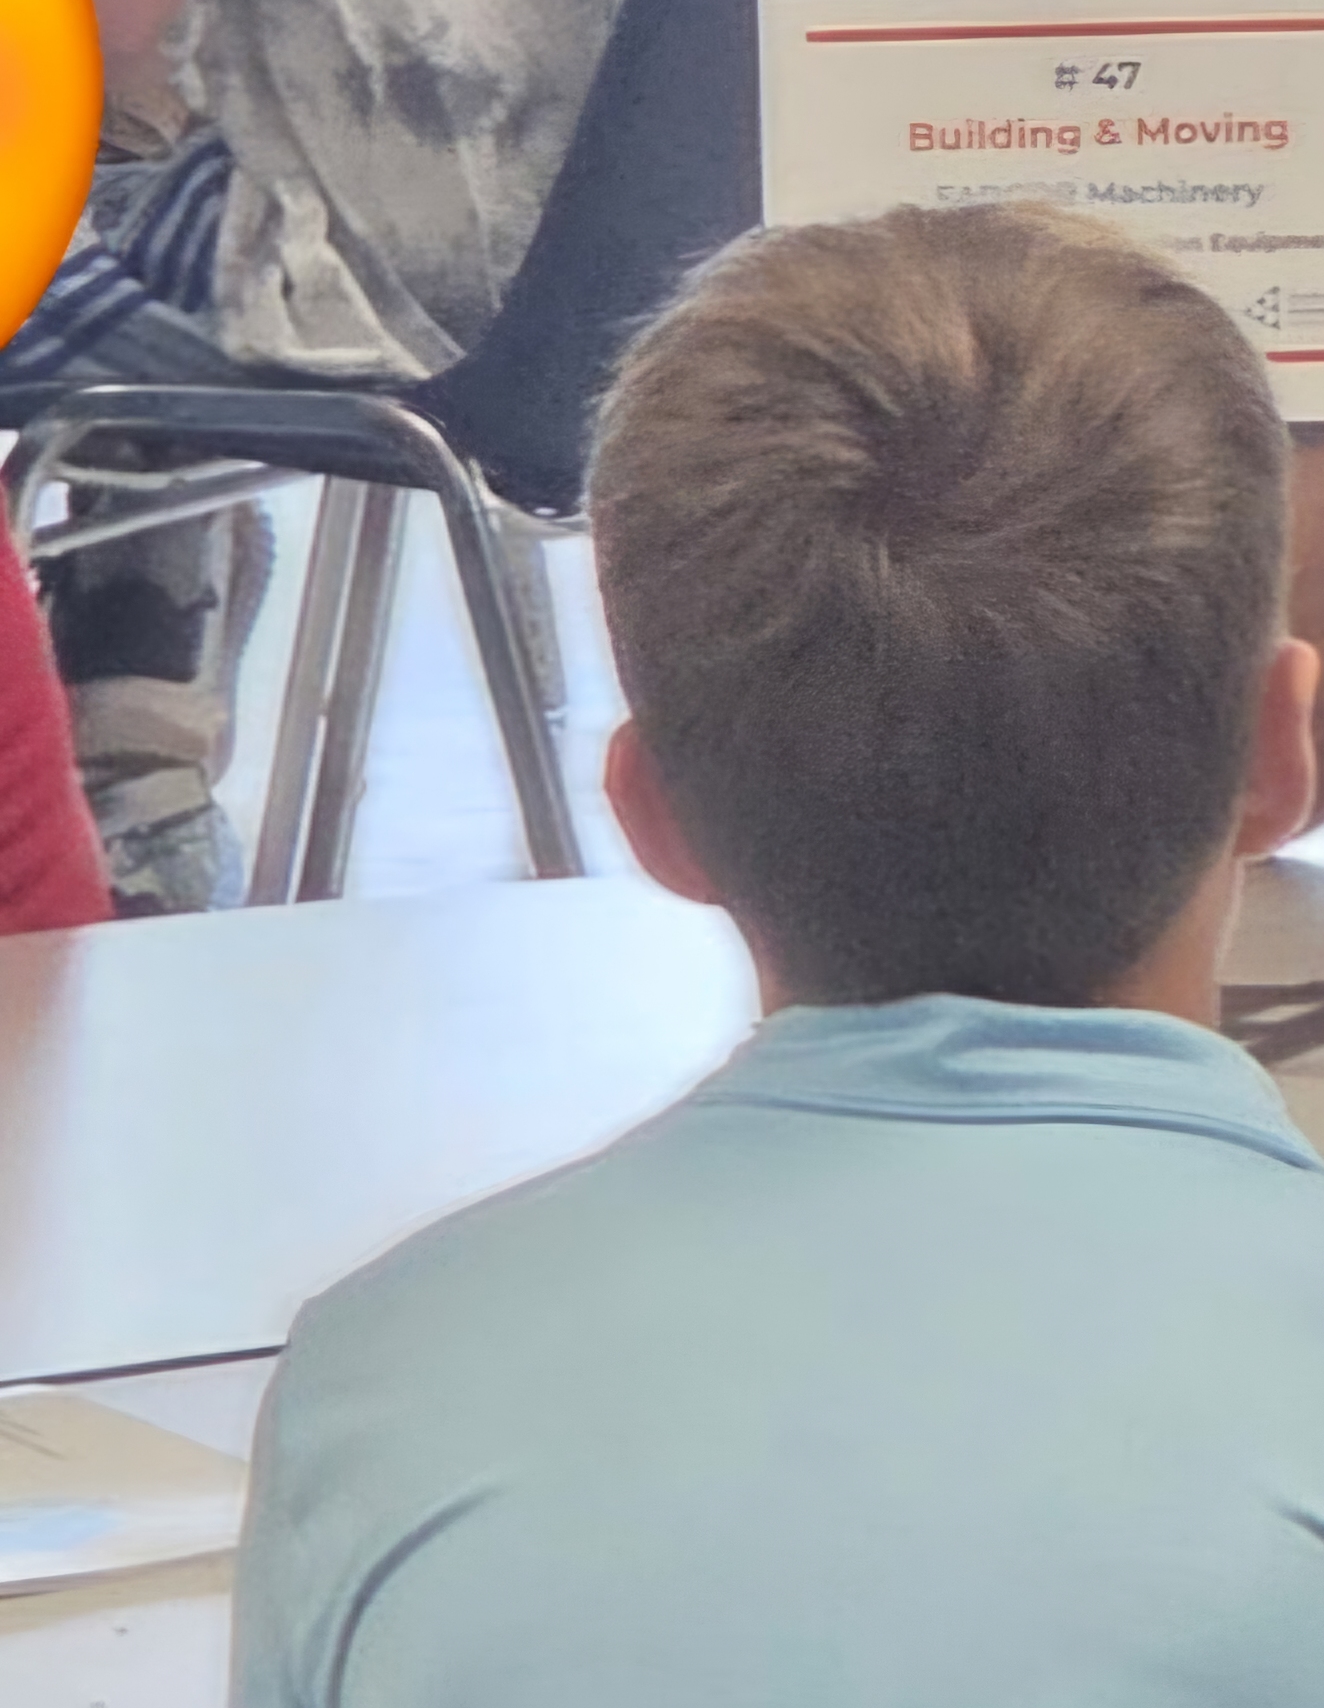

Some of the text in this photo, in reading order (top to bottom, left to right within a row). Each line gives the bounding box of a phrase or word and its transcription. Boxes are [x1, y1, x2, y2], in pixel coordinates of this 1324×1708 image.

[1091, 60, 1143, 91] 47
[908, 112, 1290, 154] Building & Moving
